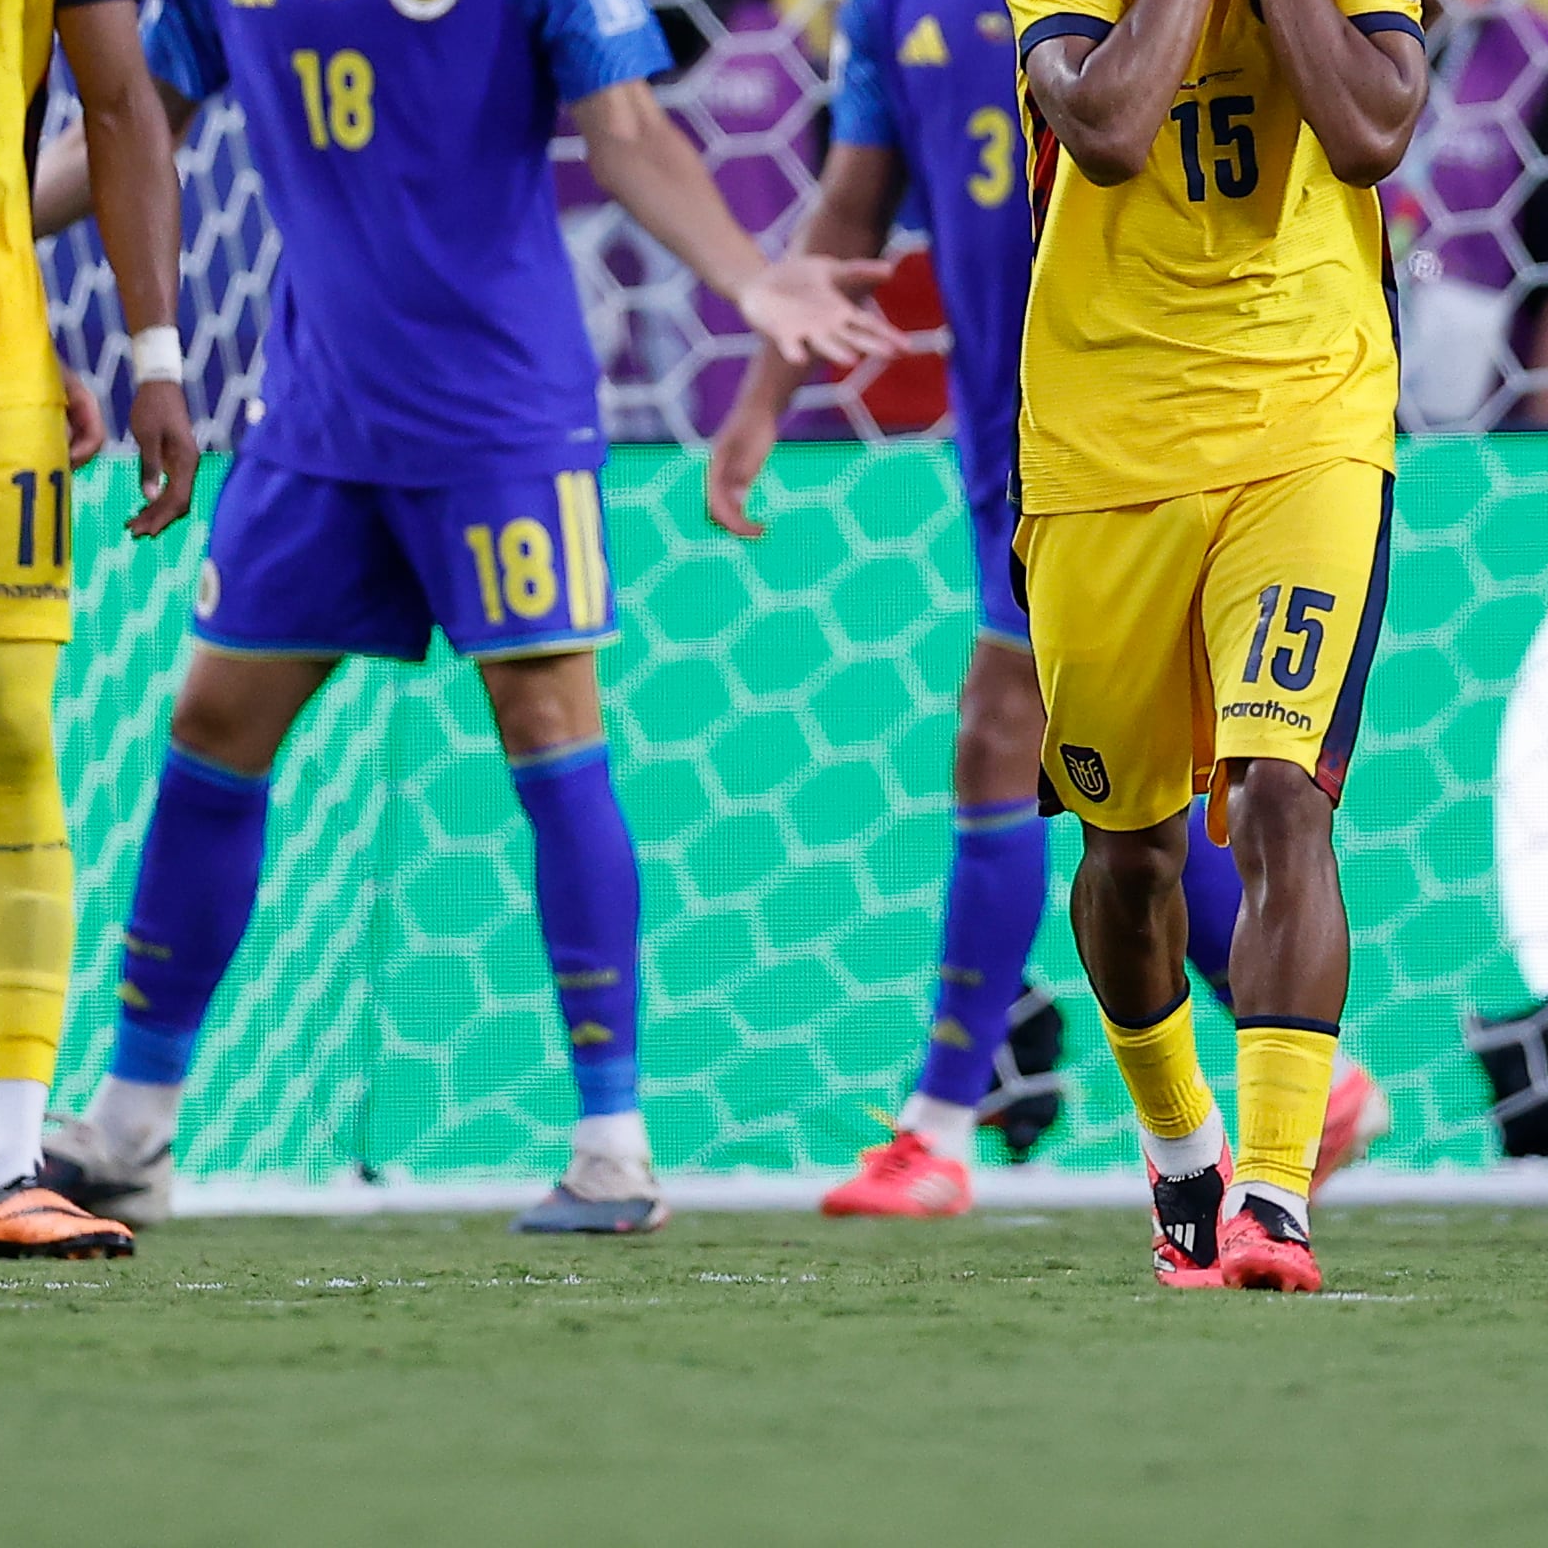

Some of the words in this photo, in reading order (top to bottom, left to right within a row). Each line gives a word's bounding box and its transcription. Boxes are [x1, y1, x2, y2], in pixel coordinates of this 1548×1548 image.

[292, 48, 376, 152] 18
[1170, 95, 1259, 202] 15
[966, 105, 1015, 209] 3
[11, 470, 64, 567] 11
[464, 517, 558, 625] 18
[1242, 584, 1336, 692] 15
[1221, 700, 1312, 731] marathon
